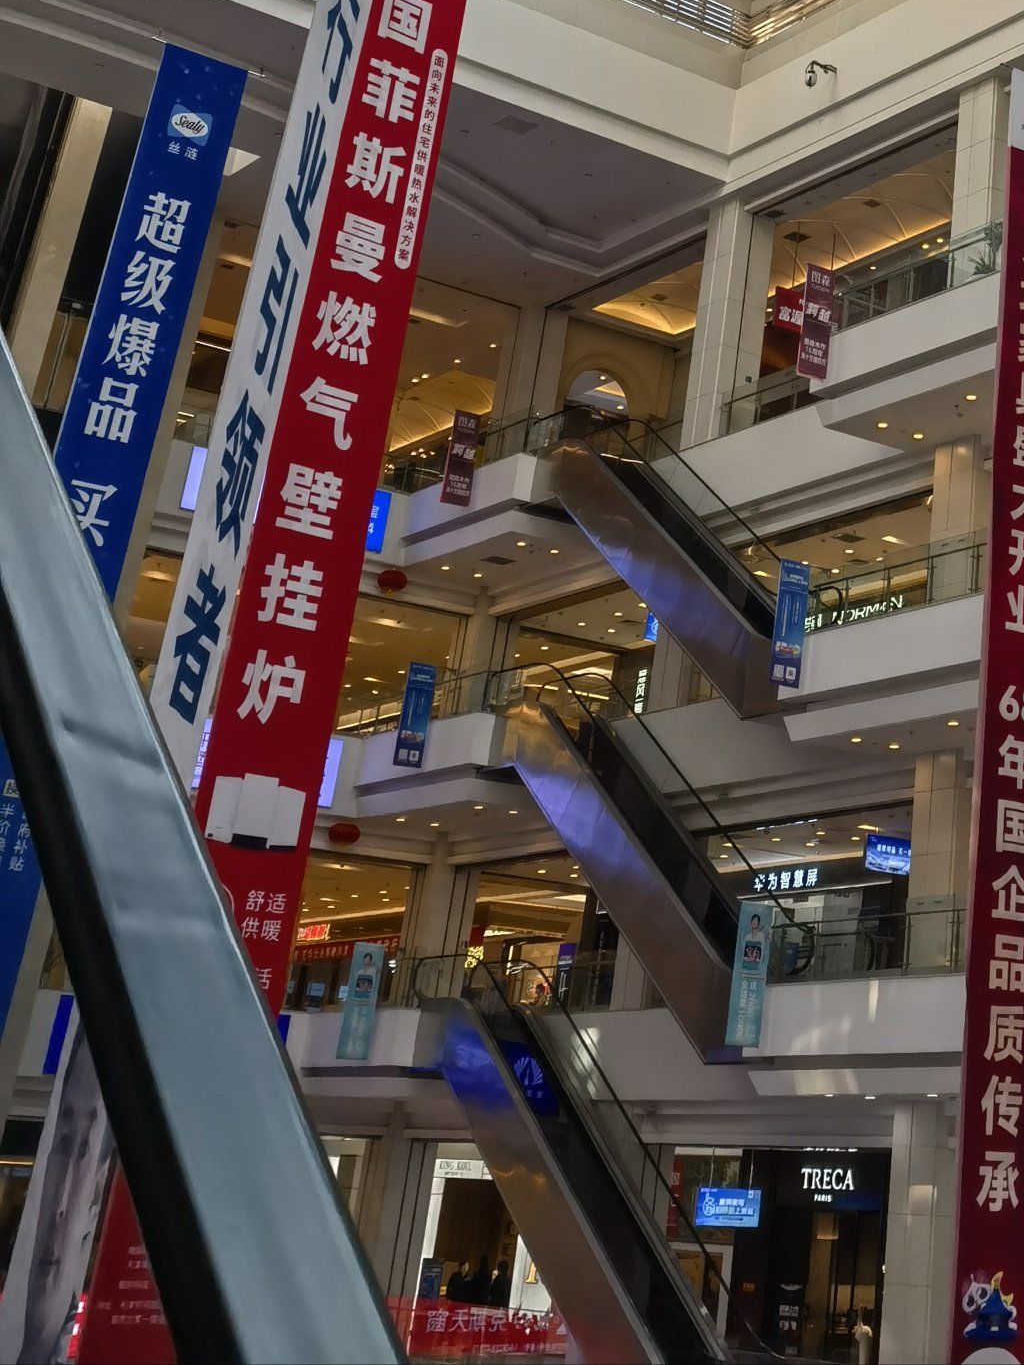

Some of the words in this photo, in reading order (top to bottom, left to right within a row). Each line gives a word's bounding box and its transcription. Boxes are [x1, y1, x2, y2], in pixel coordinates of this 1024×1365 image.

[174, 115, 205, 135] Sealy
[167, 141, 199, 161] 丝涟
[398, 55, 444, 262] 面向未来的住宅供暖热水解决方案
[82, 191, 192, 445] 超级爆品
[69, 478, 119, 548] 买
[753, 868, 818, 892] 华为智慧屏
[245, 889, 287, 915] 舒适
[241, 916, 282, 942] 供暖
[801, 1167, 854, 1191] TRECA
[814, 1193, 832, 1203] PARIS
